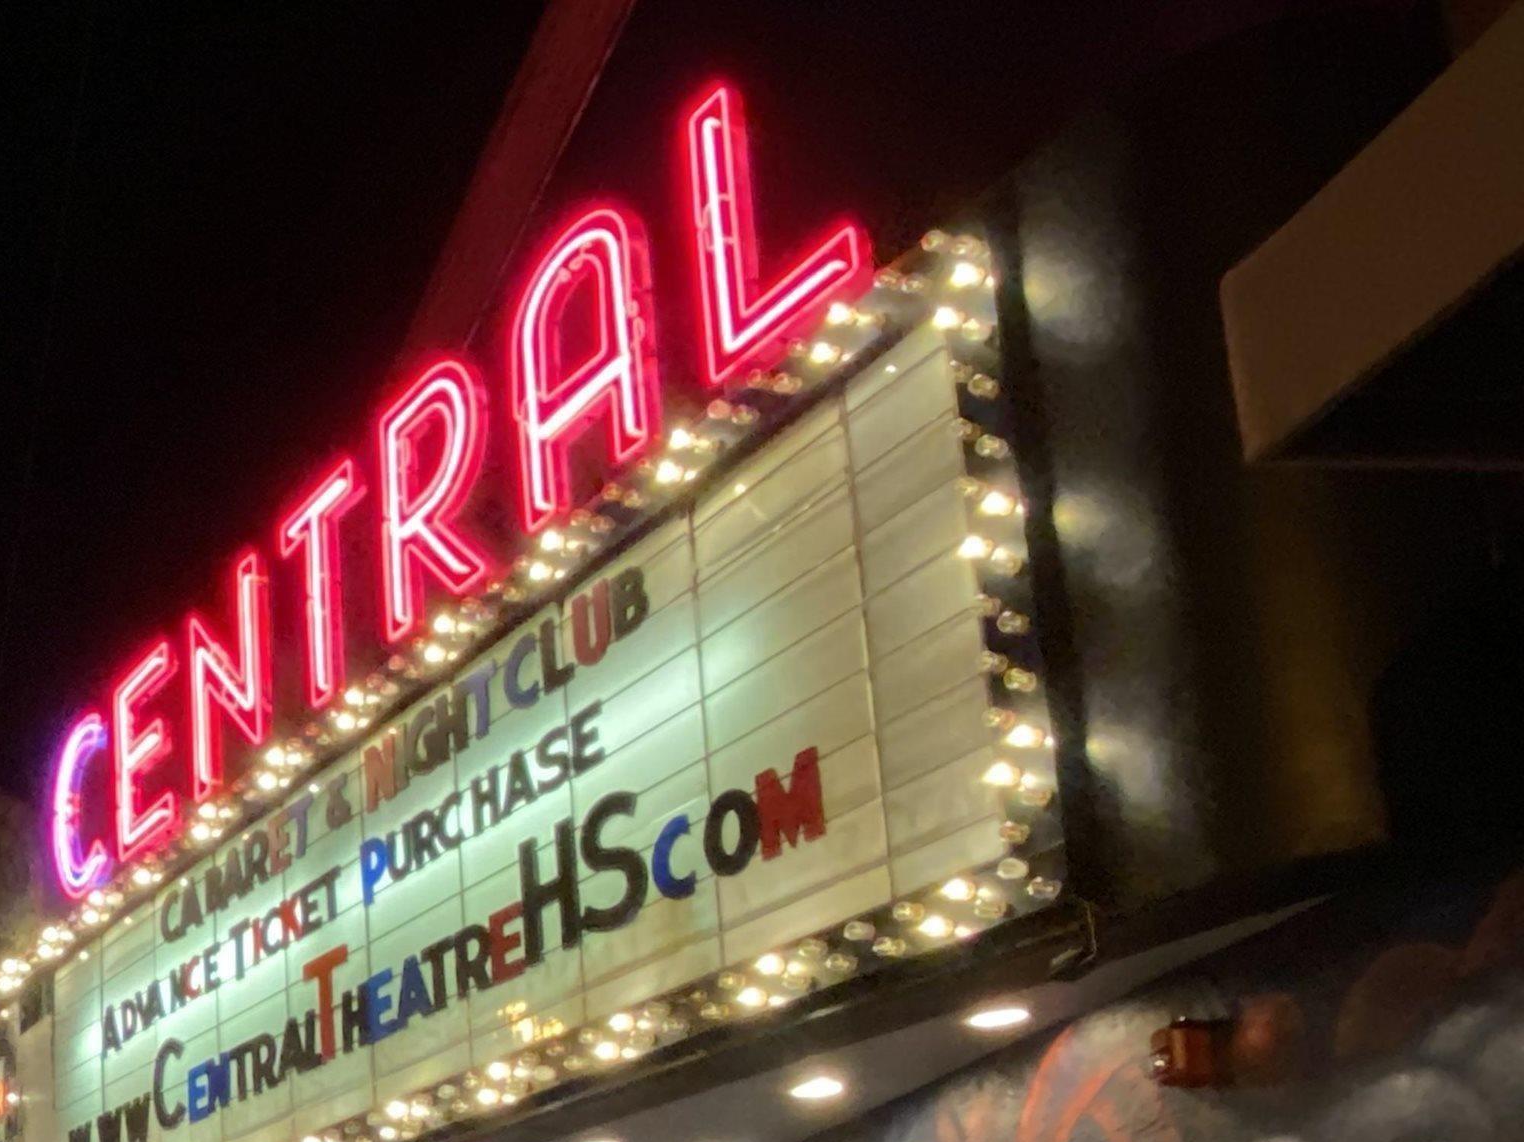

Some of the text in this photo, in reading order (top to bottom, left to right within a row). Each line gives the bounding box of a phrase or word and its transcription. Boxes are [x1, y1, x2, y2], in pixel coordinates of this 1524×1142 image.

[52, 86, 868, 898] CENTRAL
[101, 942, 222, 1059] ADVANCE
[229, 864, 342, 980] TICKET
[360, 699, 606, 907] PURCHASE
[161, 793, 314, 943] CABARET
[326, 772, 353, 831] &
